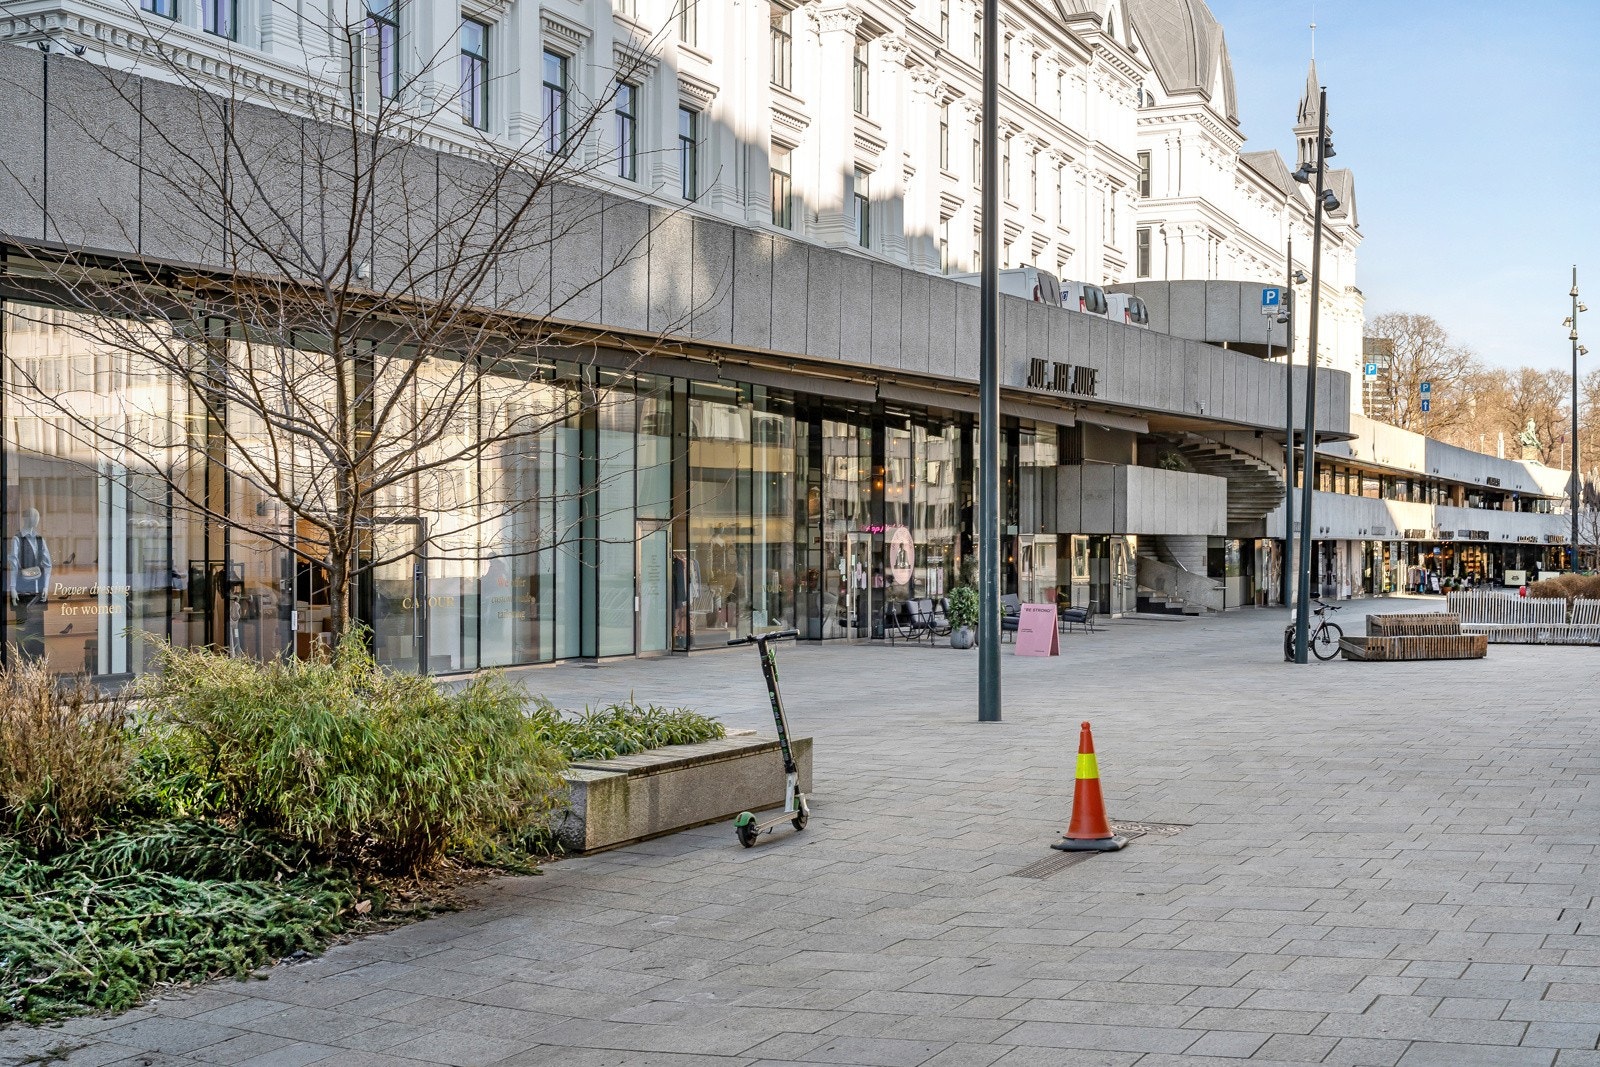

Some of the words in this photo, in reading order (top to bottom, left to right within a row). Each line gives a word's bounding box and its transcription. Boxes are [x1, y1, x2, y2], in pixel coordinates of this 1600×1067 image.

[1267, 291, 1276, 304] P
[1368, 365, 1375, 374] P
[1053, 362, 1072, 392] THE
[1071, 366, 1098, 396] JUICE
[1422, 384, 1429, 392] P
[53, 582, 88, 596] Power
[89, 582, 131, 597] dressing
[61, 602, 78, 616] for
[81, 604, 122, 615] women
[402, 596, 455, 610] CAOUR
